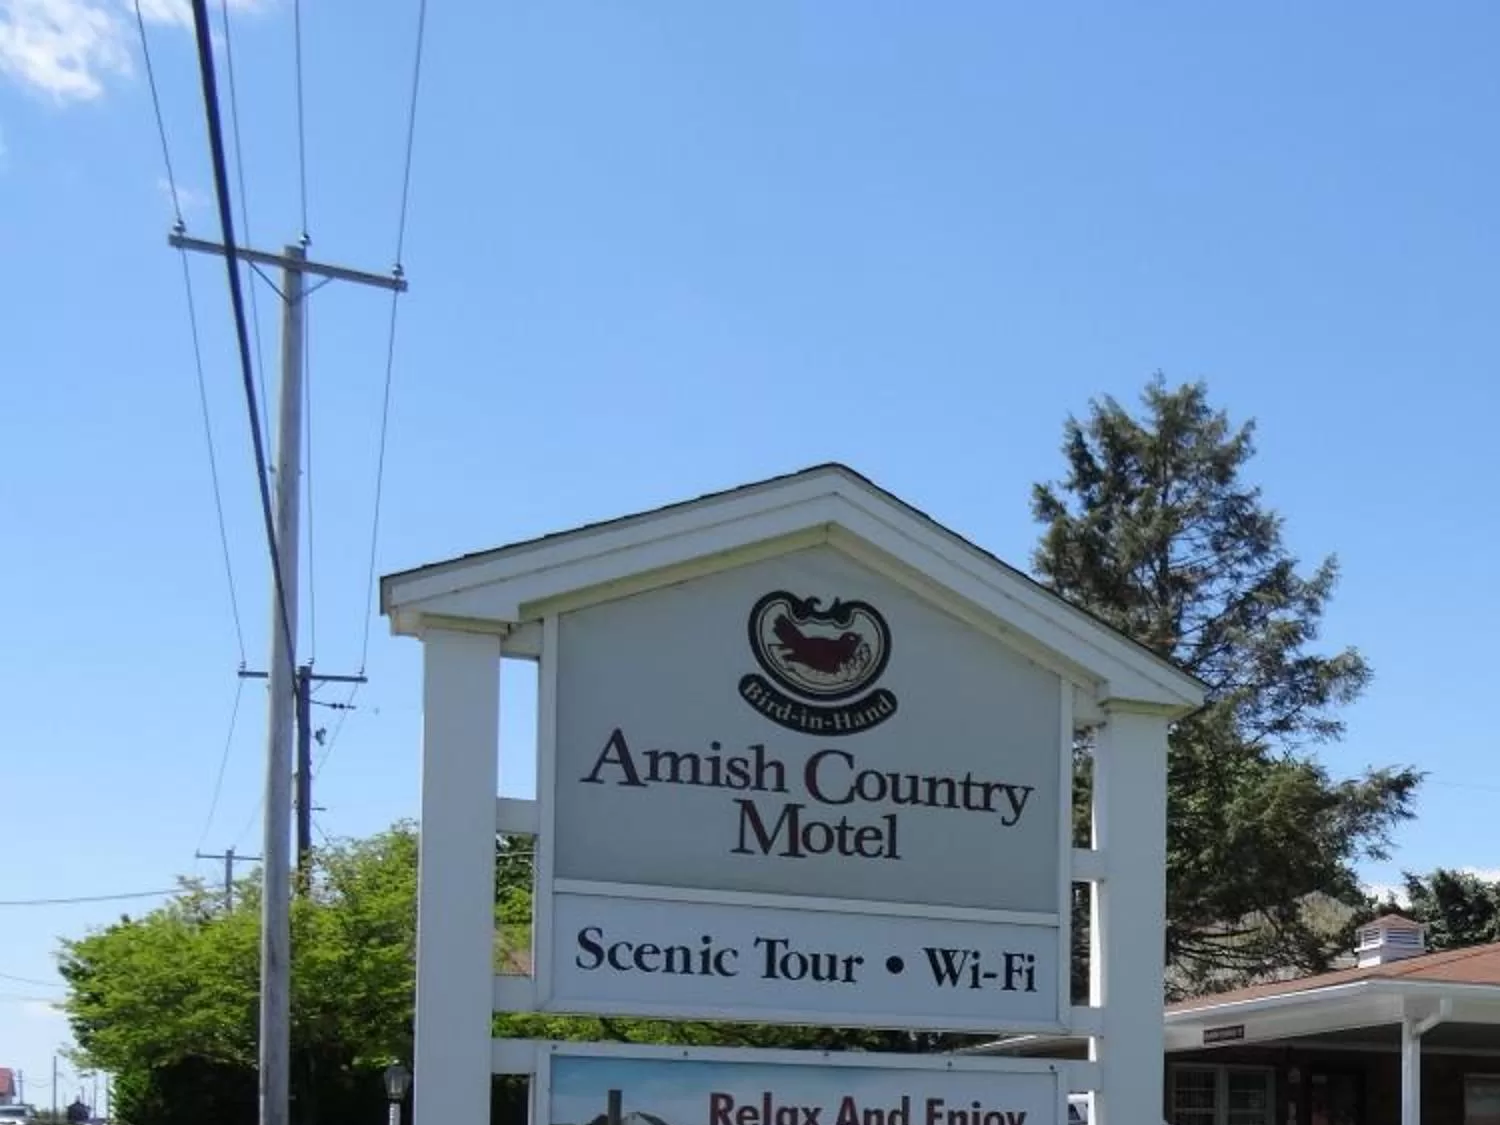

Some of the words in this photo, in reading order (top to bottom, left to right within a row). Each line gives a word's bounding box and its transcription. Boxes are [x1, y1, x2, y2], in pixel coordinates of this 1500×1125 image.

[744, 680, 894, 731] Bird-in-Hand
[580, 727, 789, 794] Amish
[803, 749, 1035, 827] Country
[729, 799, 902, 860] Motel
[575, 926, 740, 978] Scenic
[754, 936, 865, 984] Tour
[923, 946, 1038, 993] Wi-Fi
